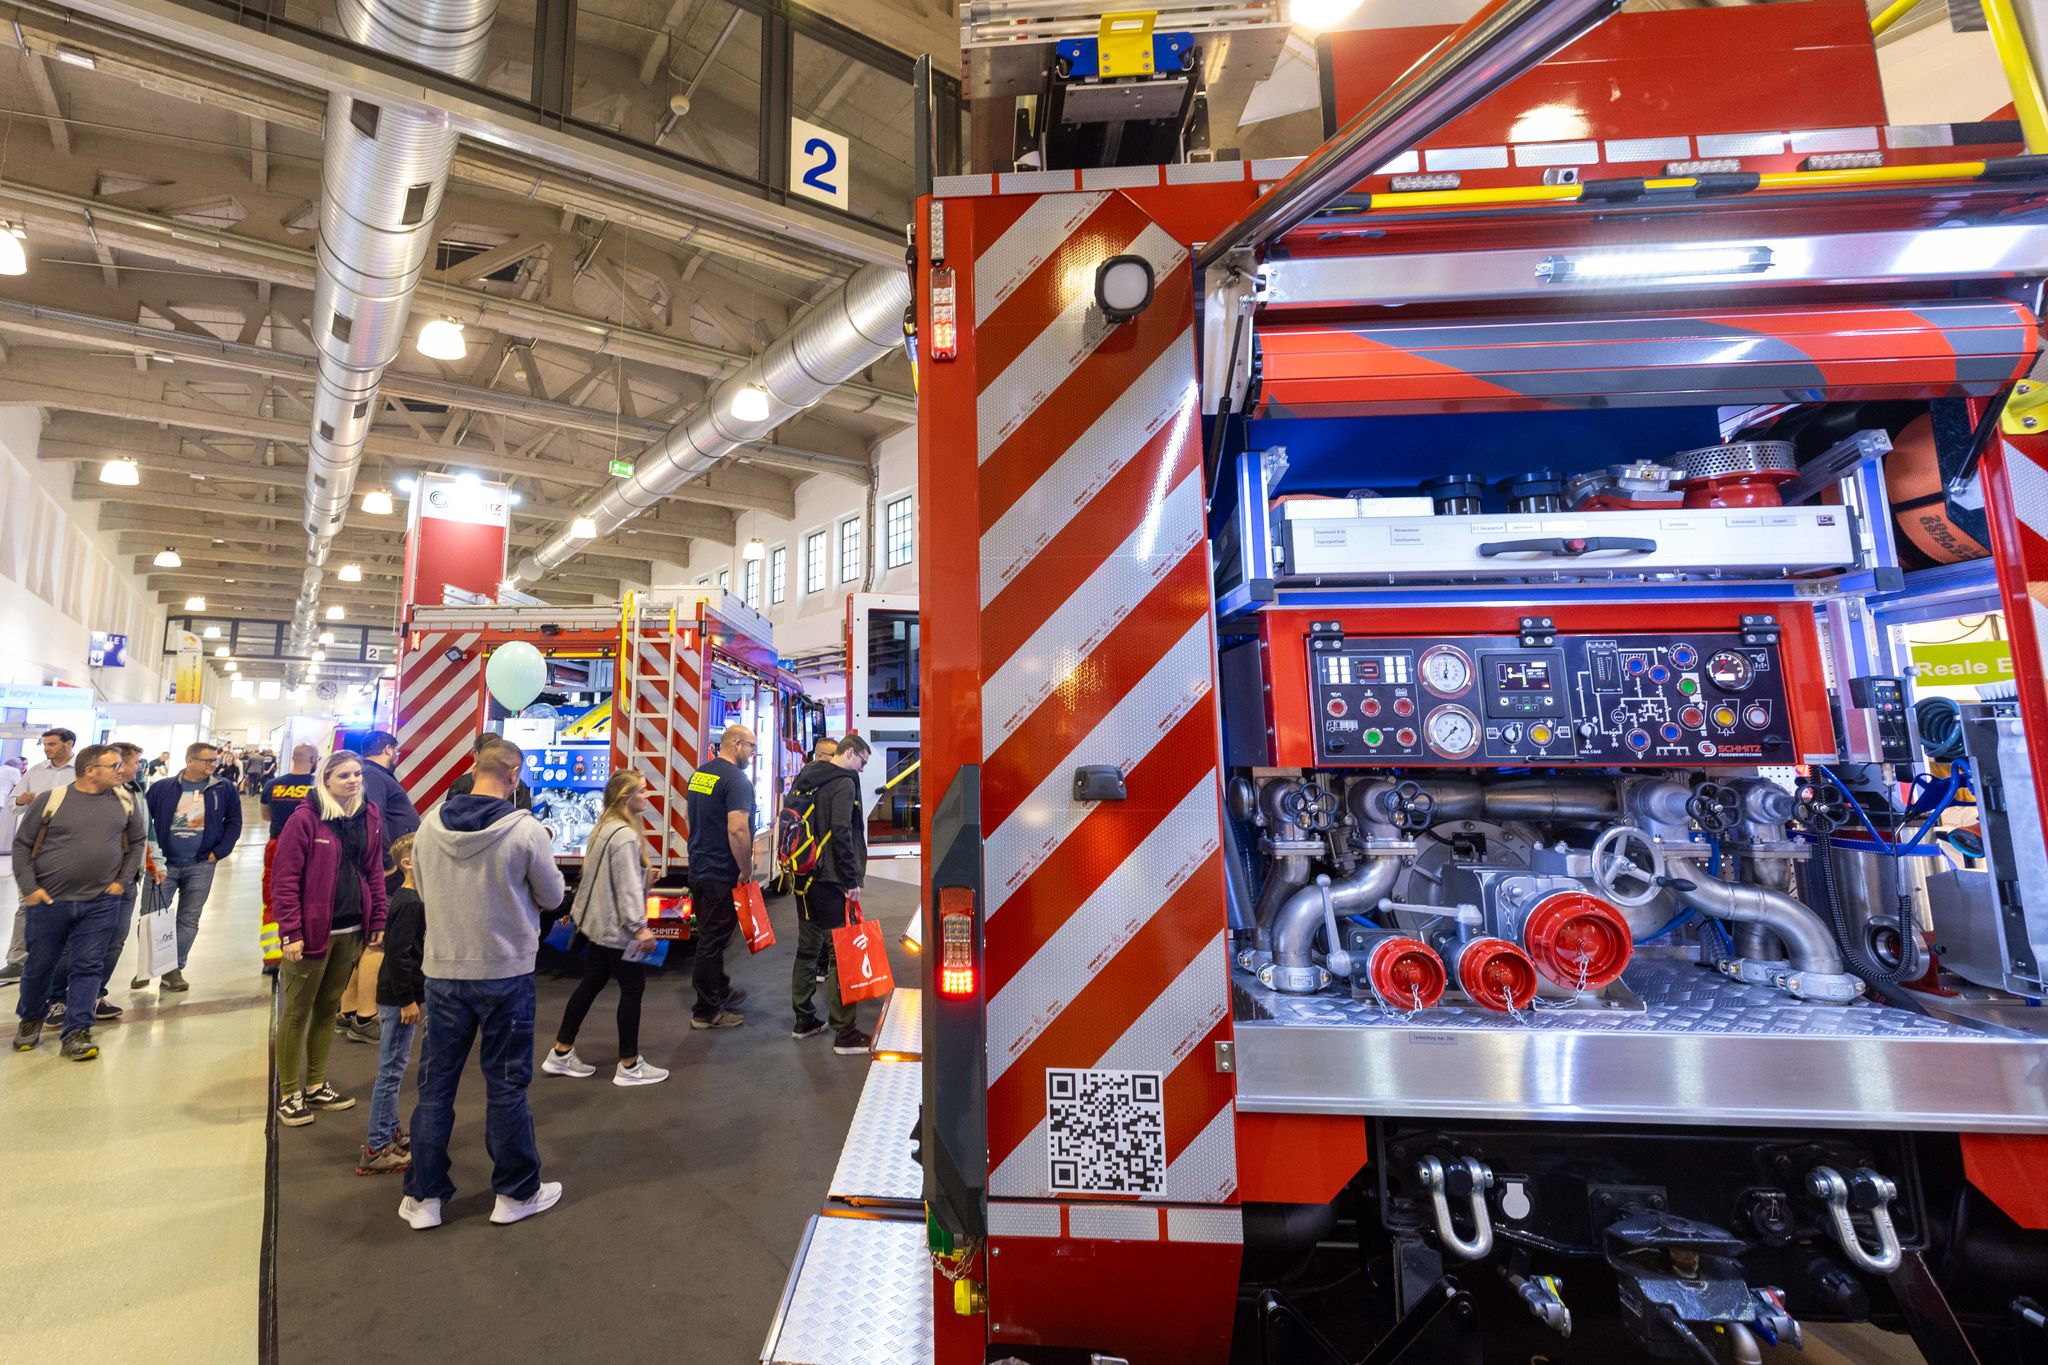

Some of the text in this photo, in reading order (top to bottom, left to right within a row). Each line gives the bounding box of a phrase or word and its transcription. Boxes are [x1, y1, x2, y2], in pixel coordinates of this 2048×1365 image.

[803, 137, 837, 195] 2
[369, 648, 377, 659] 2
[1916, 659, 1988, 677] Reale
